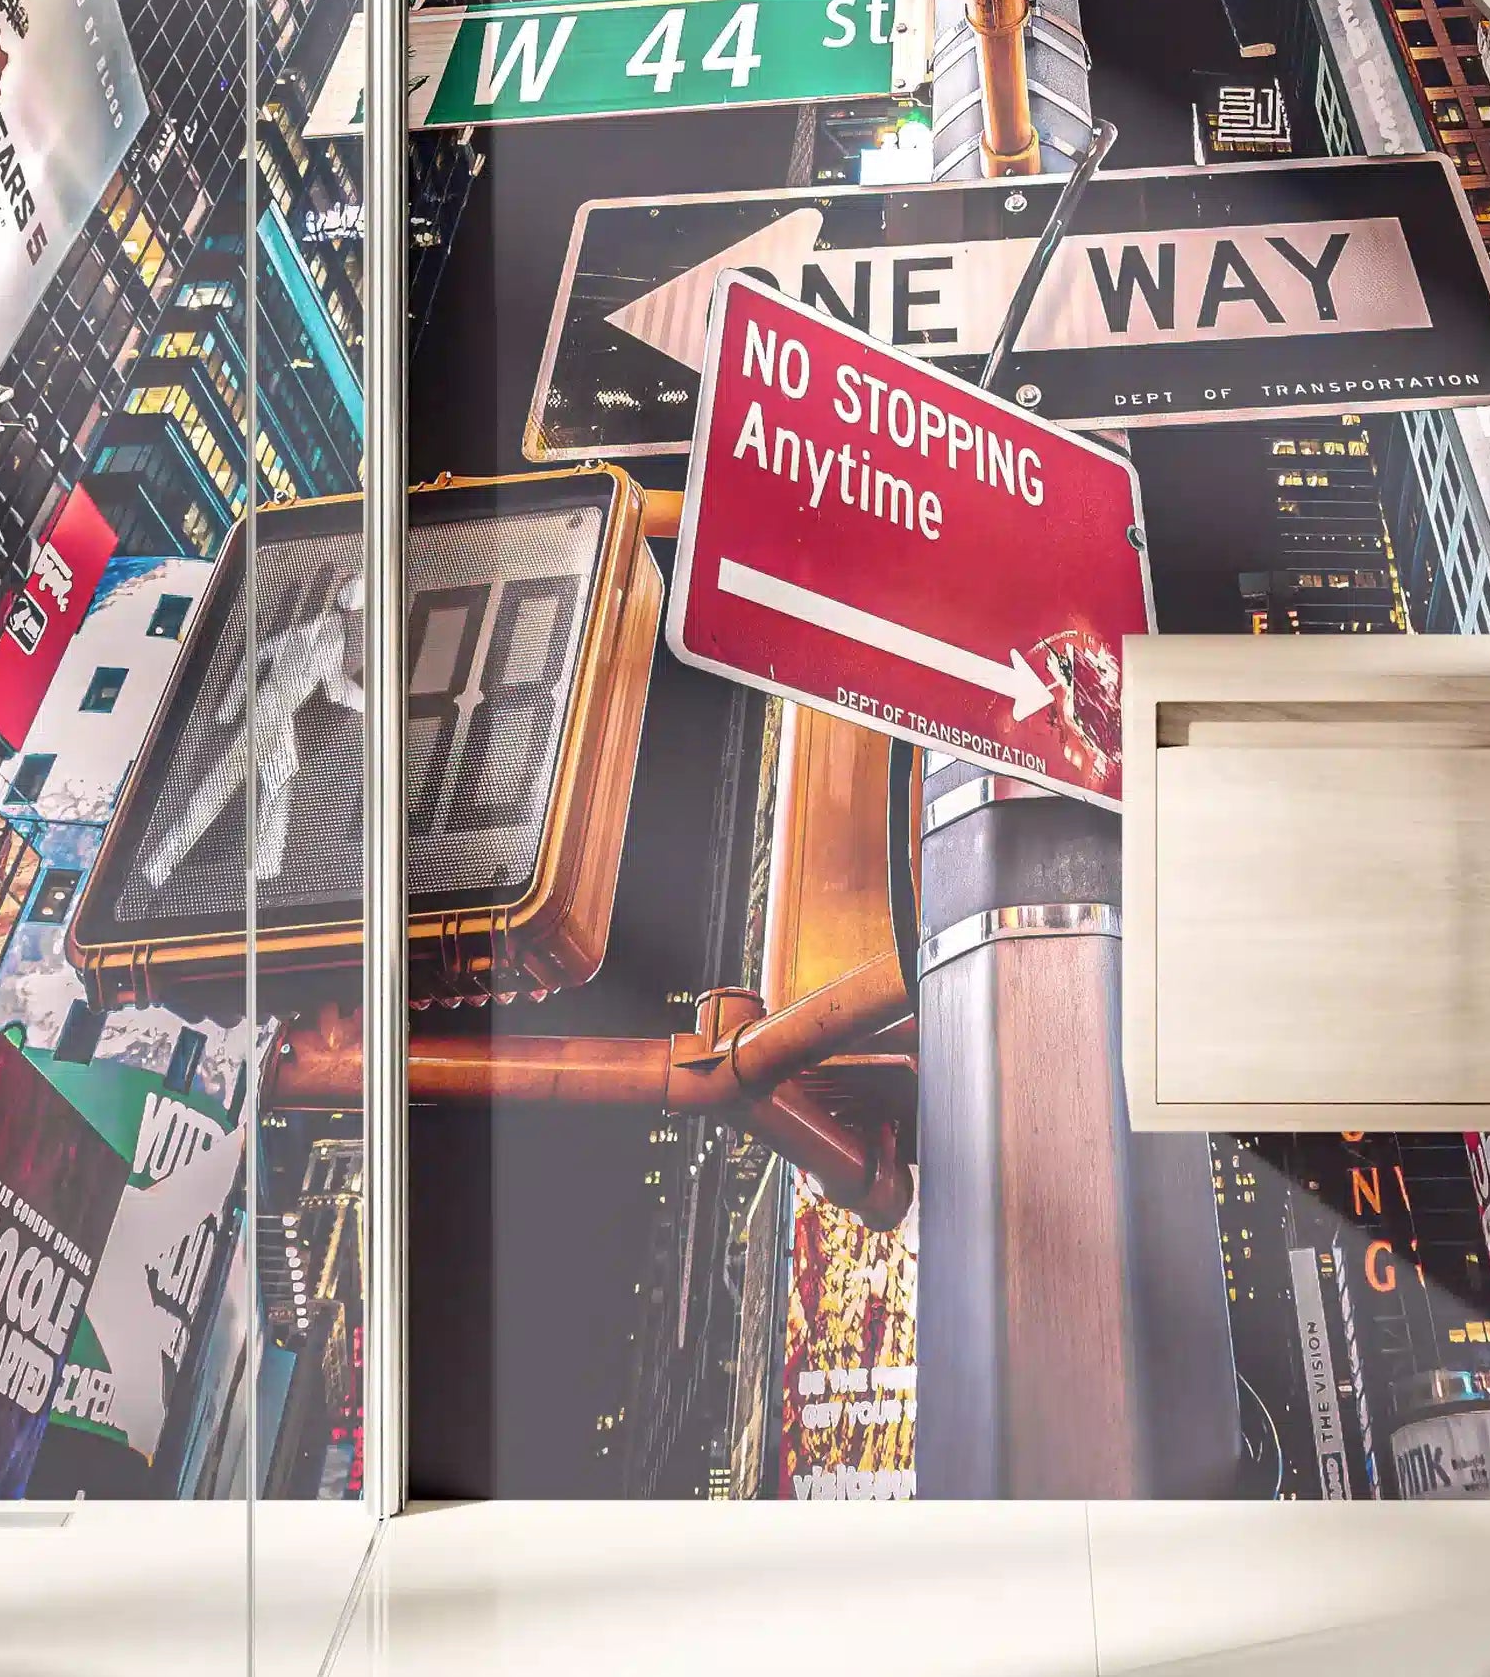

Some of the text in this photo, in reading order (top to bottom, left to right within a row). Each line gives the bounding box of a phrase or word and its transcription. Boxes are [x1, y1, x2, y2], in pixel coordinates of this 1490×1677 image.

[475, 15, 577, 106] W
[625, 3, 762, 92] 44
[23, 221, 50, 266] 5
[733, 232, 1350, 345] NE WAY
[742, 319, 1045, 507] NO STOPPING
[1114, 373, 1481, 406] DEPT OF TRANSPORTATION
[733, 401, 943, 541] Anytime
[836, 686, 1047, 774] DEPT OF TRANSPORTATION
[1305, 1320, 1326, 1393] VISION
[1317, 1401, 1334, 1442] THE
